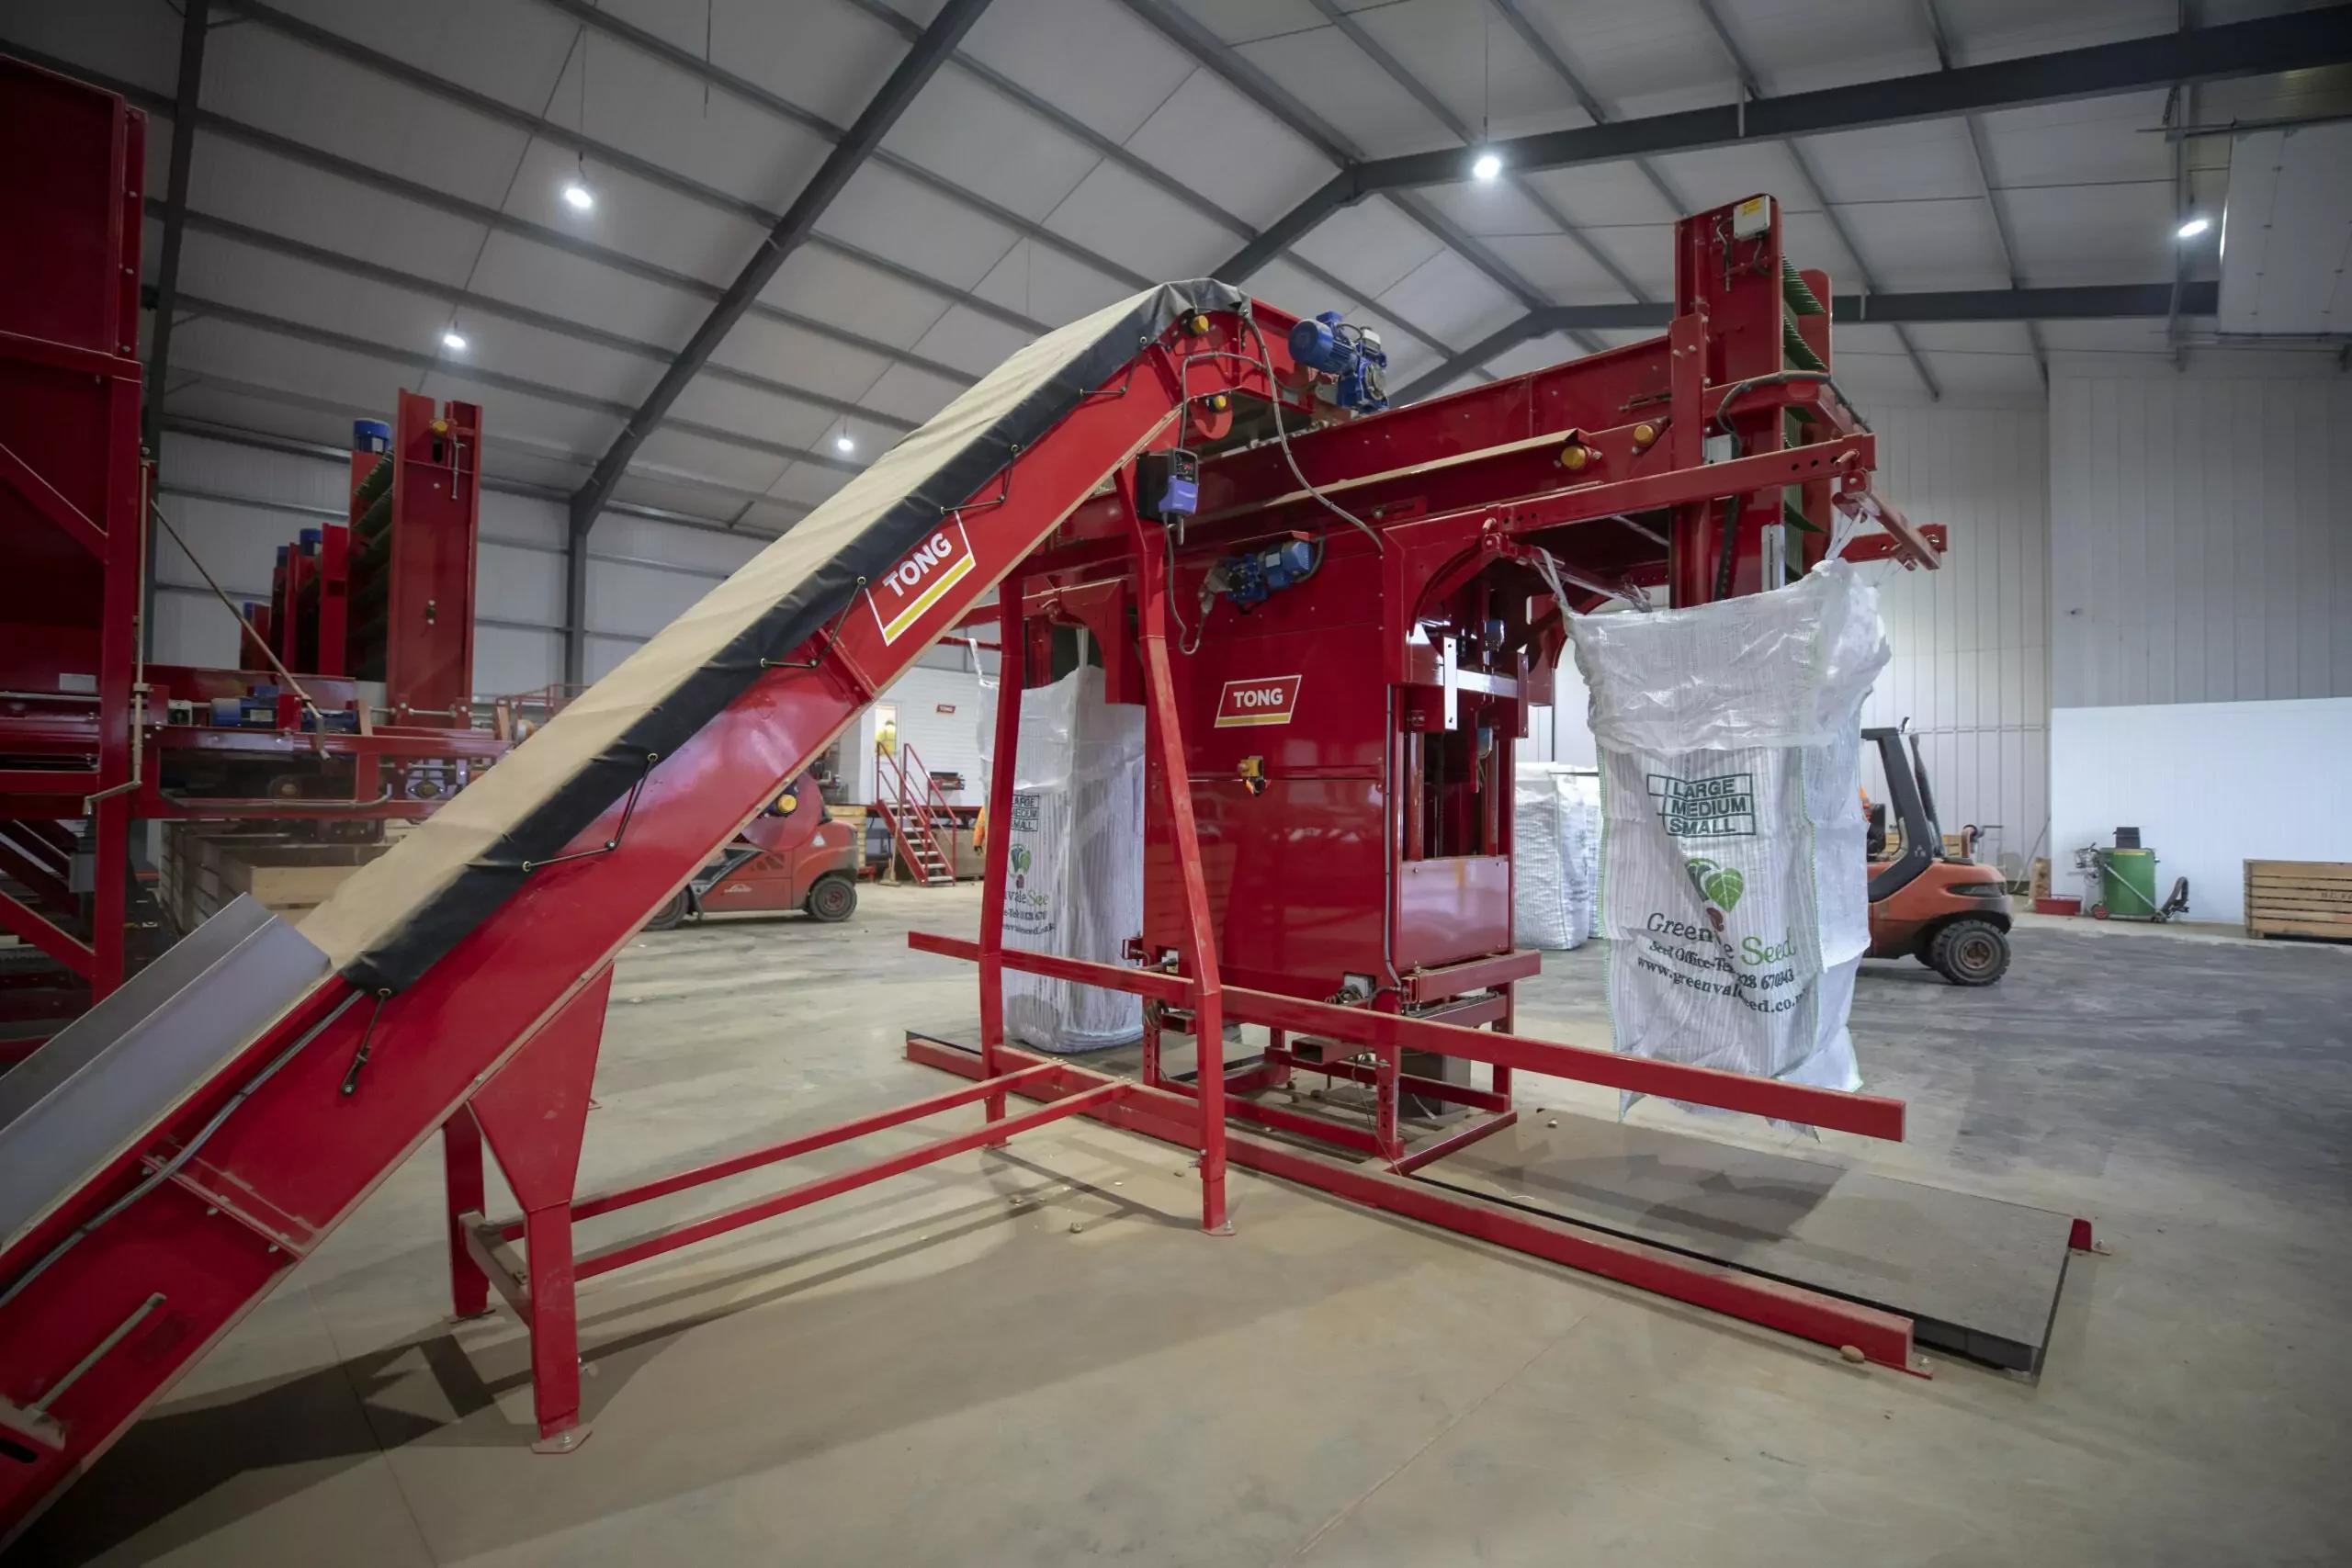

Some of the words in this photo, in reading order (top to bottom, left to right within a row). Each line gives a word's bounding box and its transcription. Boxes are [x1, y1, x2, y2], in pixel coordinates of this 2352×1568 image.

[882, 533, 953, 597] TONG
[1233, 687, 1283, 708] TONG
[1672, 778, 1736, 799] LARGE
[1671, 796, 1747, 818] MEDIUM
[1669, 818, 1736, 835] SMALL
[1649, 940, 1673, 961] Seed
[1740, 926, 1797, 966] Seed
